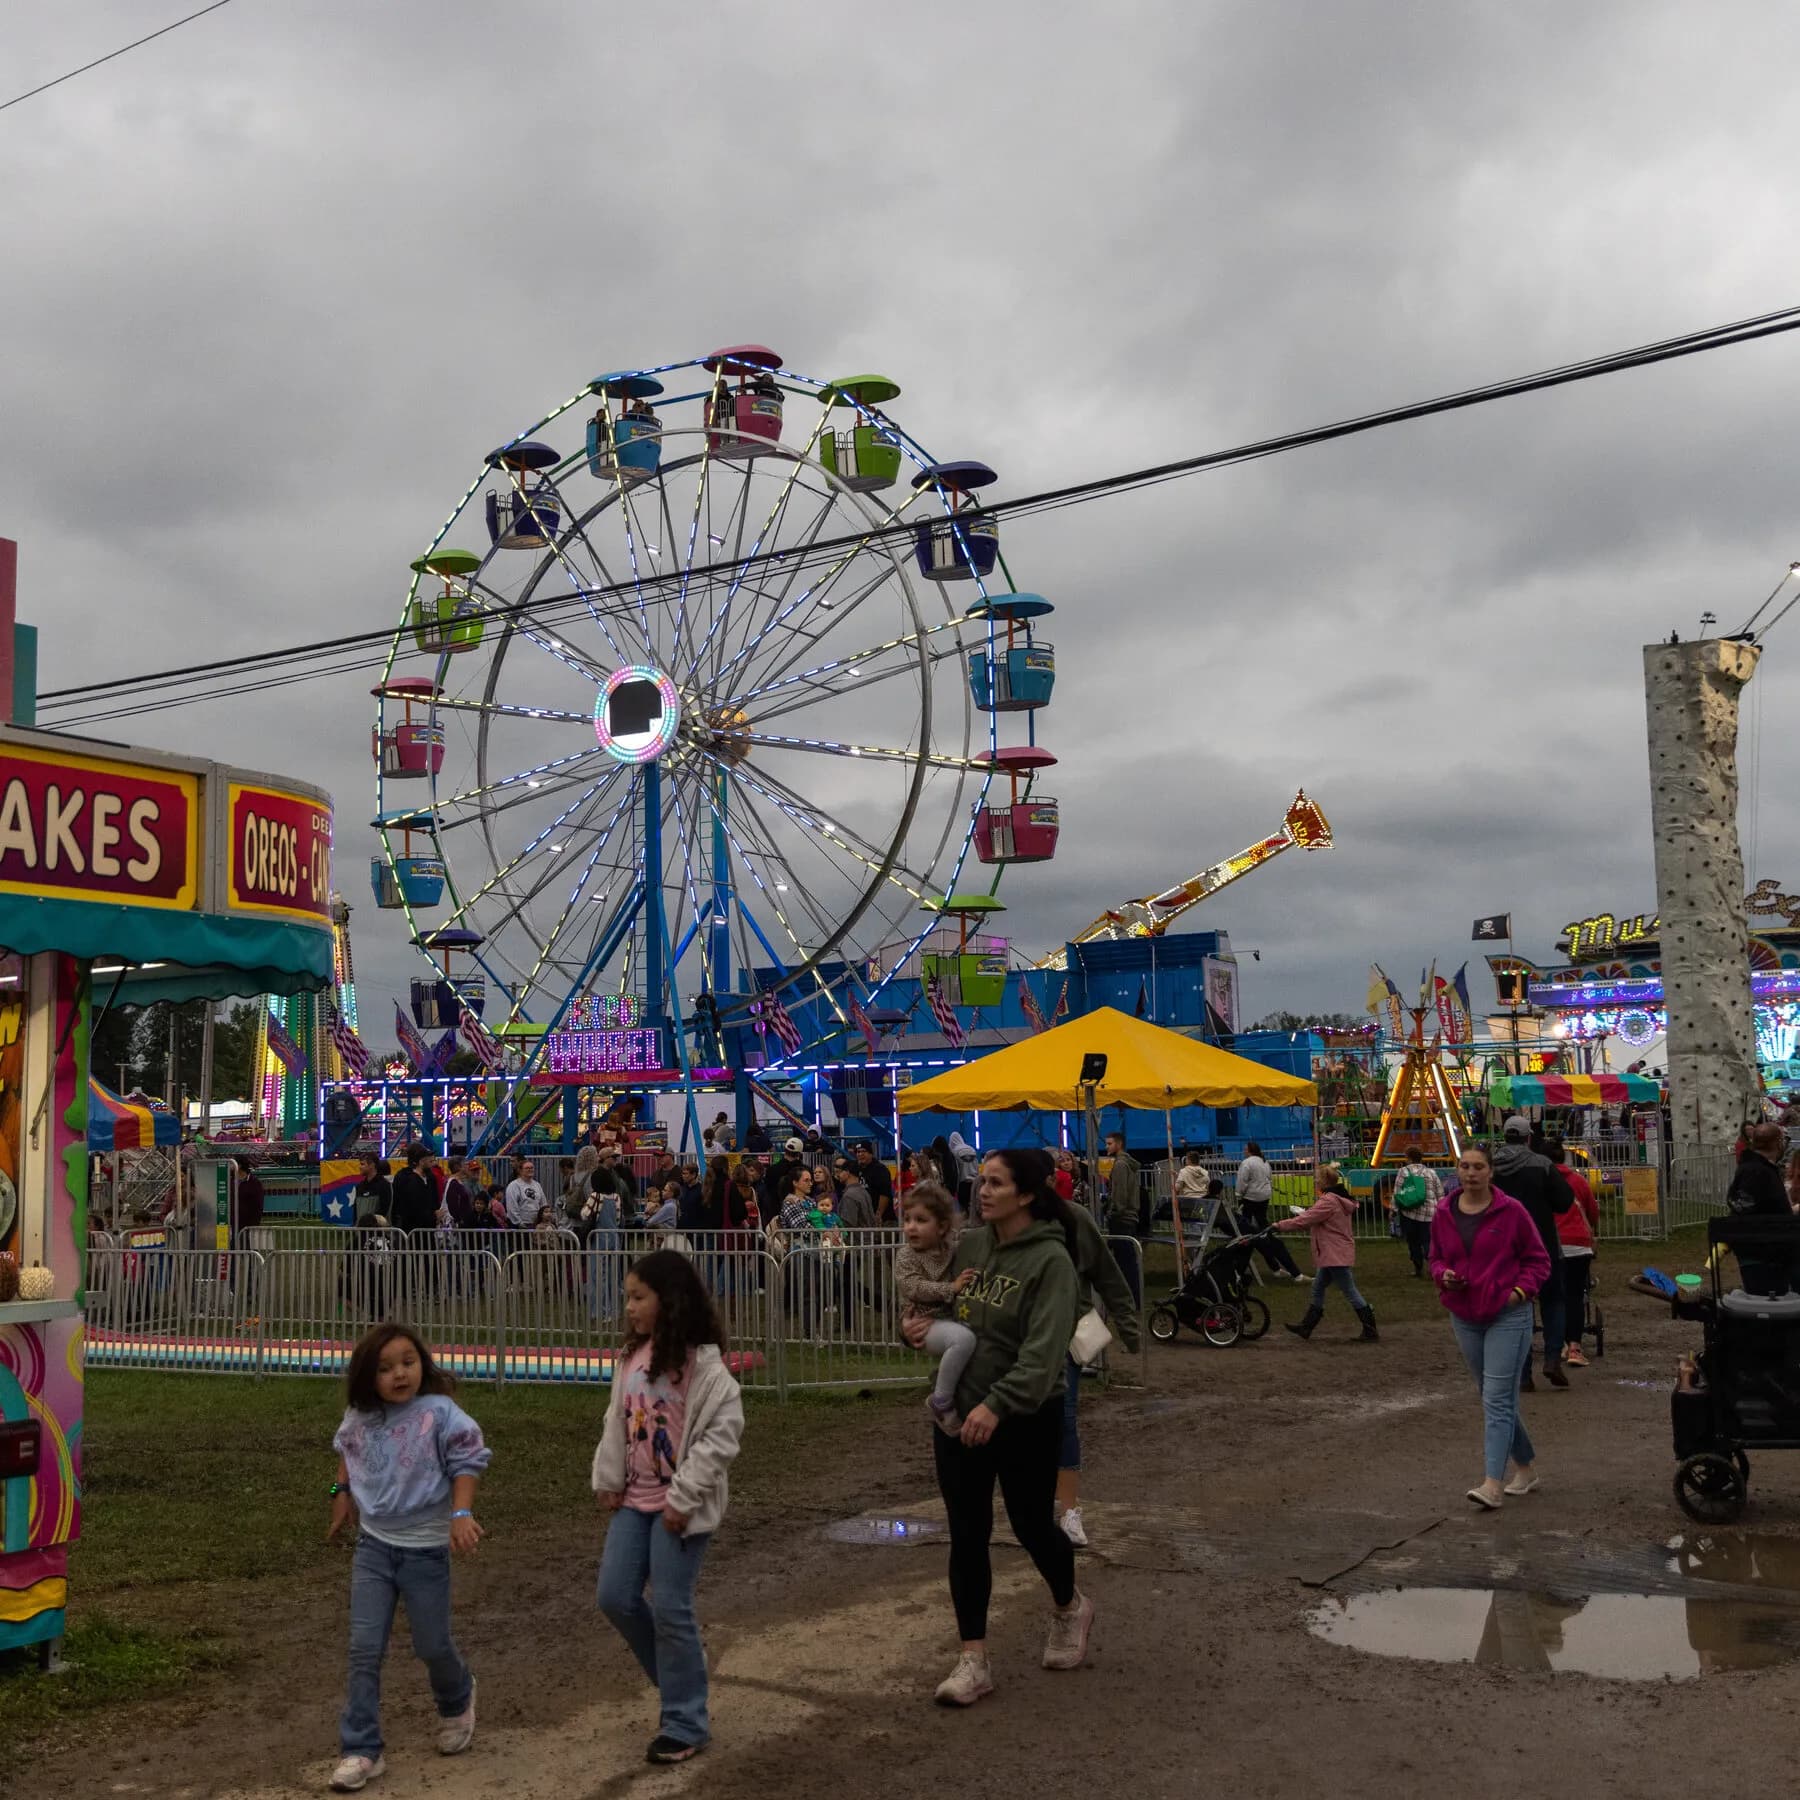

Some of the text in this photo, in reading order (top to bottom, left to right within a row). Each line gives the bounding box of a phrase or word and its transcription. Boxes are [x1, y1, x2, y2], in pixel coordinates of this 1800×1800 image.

[0, 778, 161, 883] AKES
[244, 811, 330, 906] OREOS CAN
[1561, 913, 1660, 962] Mu
[568, 994, 640, 1030] EXPO
[548, 1029, 662, 1072] WHEEL
[583, 1072, 629, 1082] ENTRANCE
[957, 1272, 1020, 1307] MY
